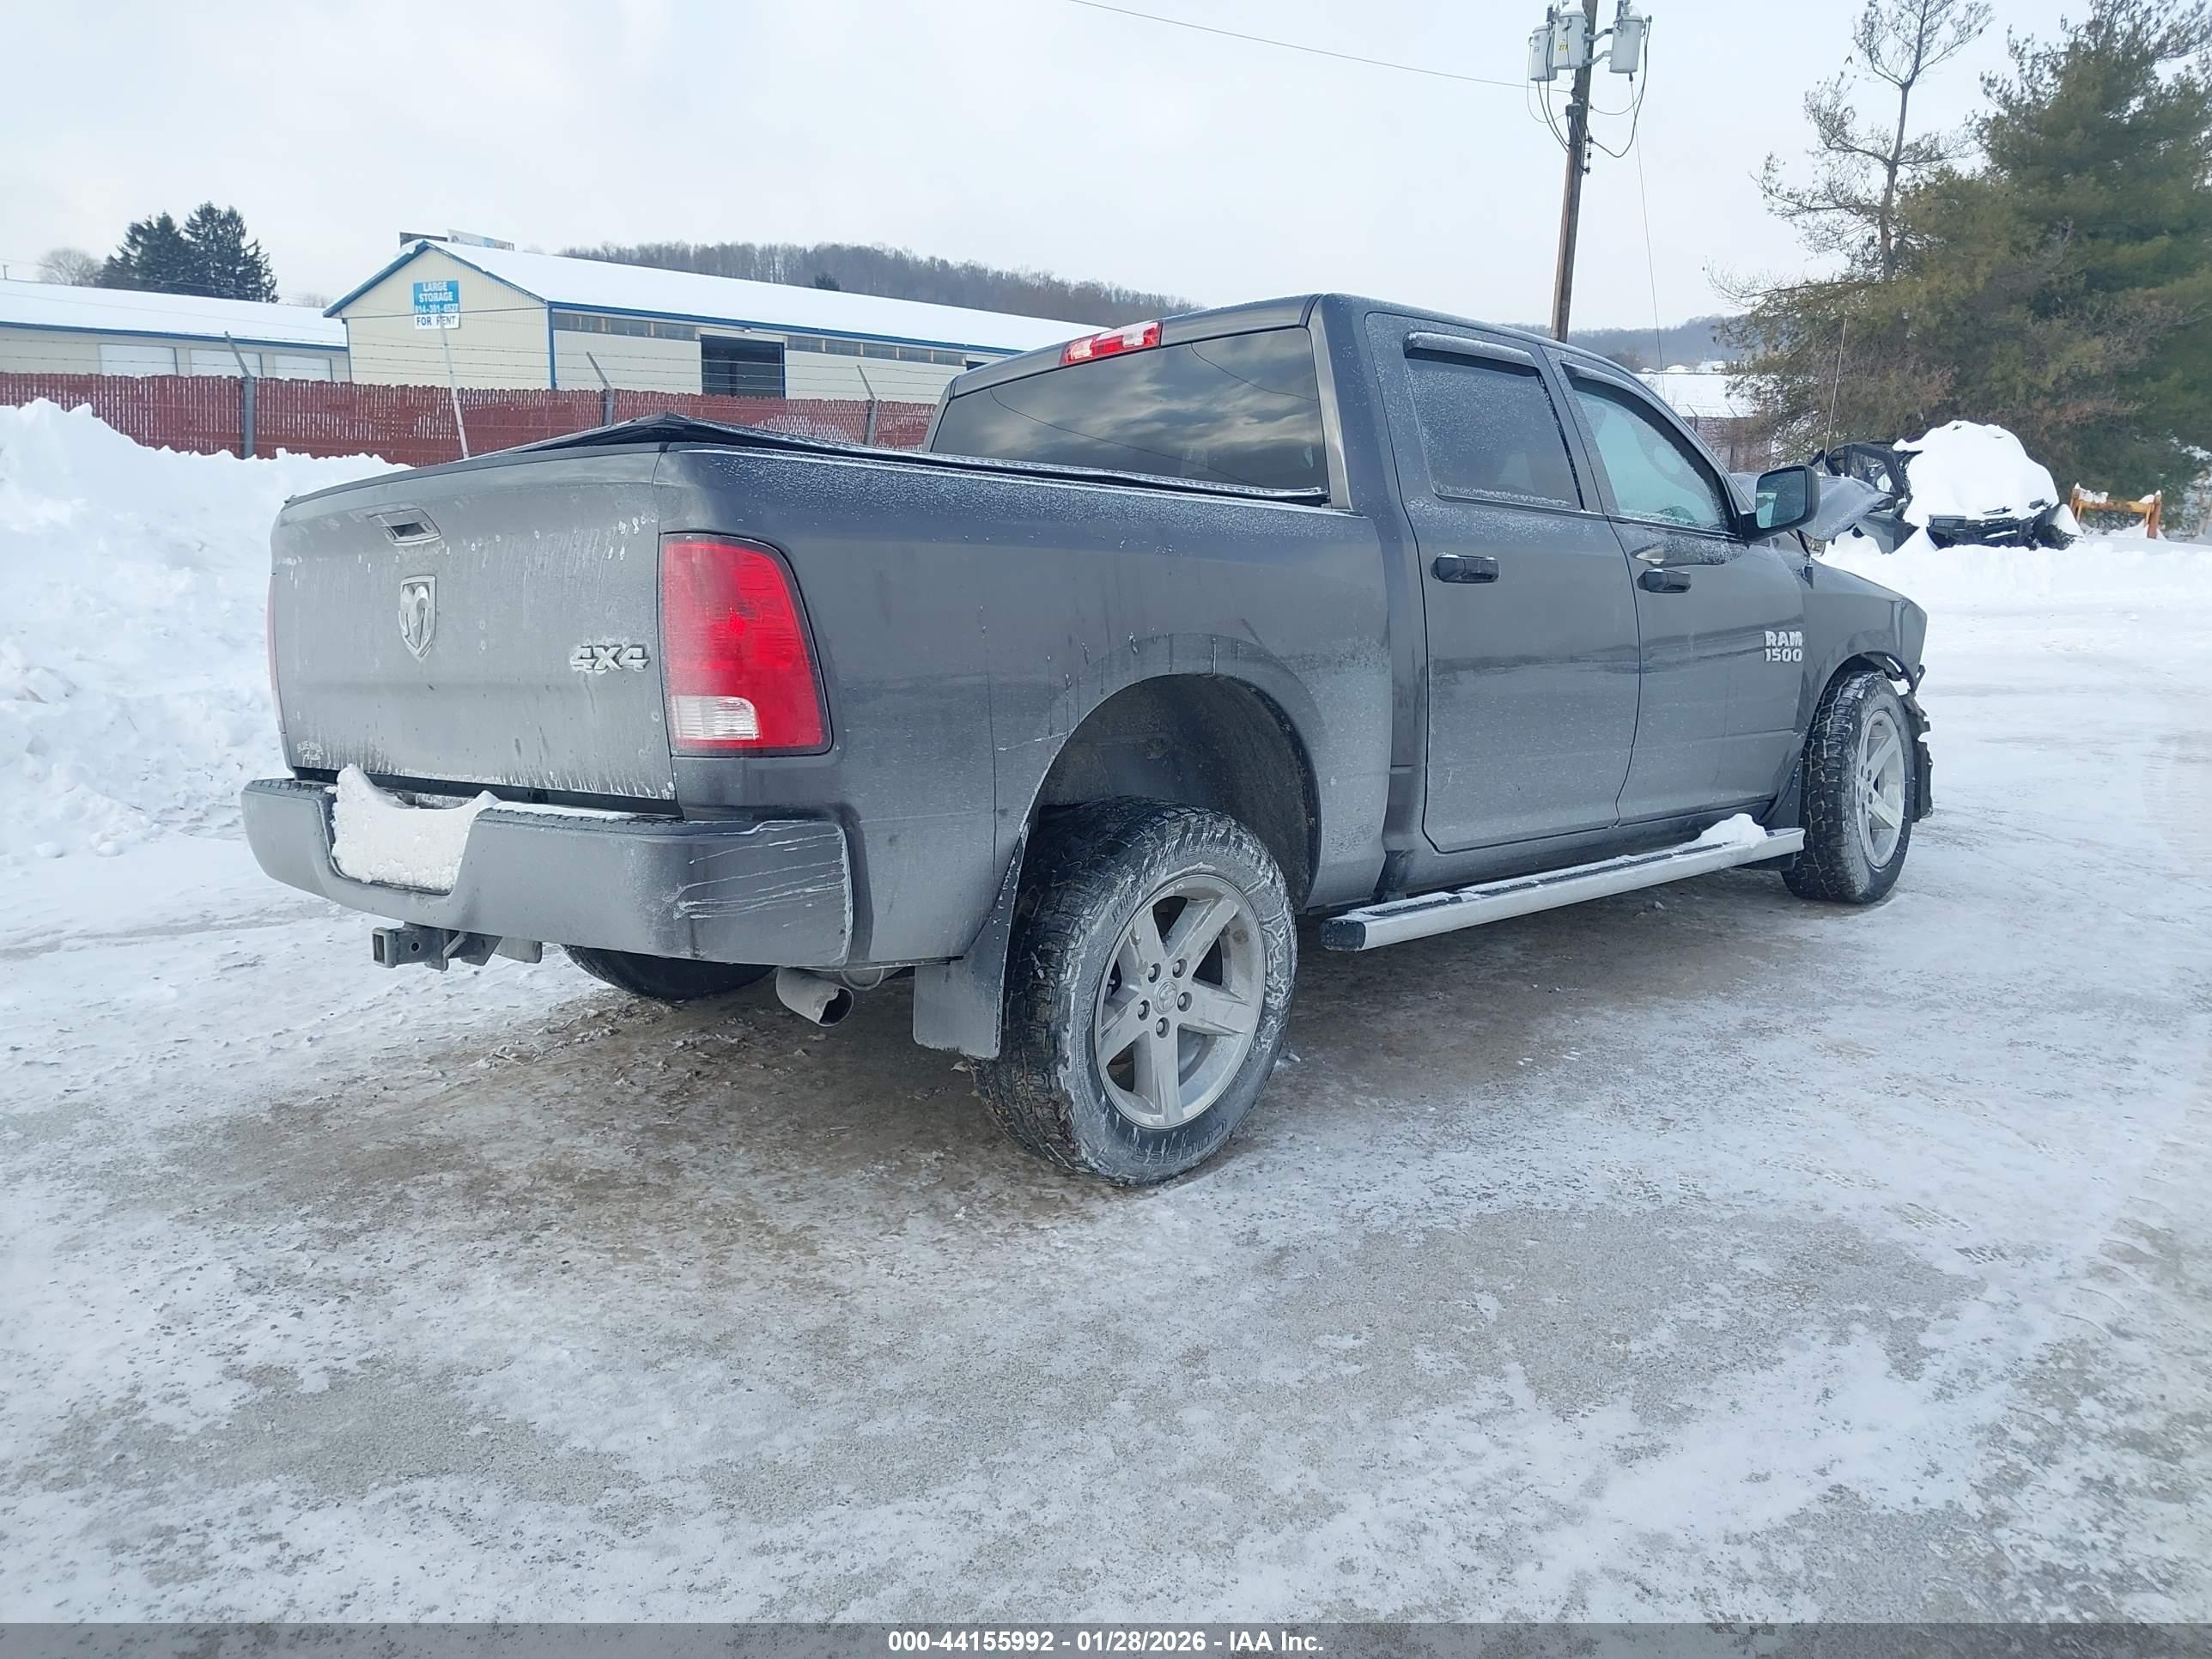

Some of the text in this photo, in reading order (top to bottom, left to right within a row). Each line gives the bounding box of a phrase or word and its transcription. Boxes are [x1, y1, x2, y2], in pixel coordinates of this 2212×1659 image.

[422, 282, 448, 292] LARGE
[418, 291, 454, 302] STORAGE
[416, 316, 432, 326] FOR
[1765, 631, 1803, 647] RAM
[1765, 647, 1802, 662] 1500
